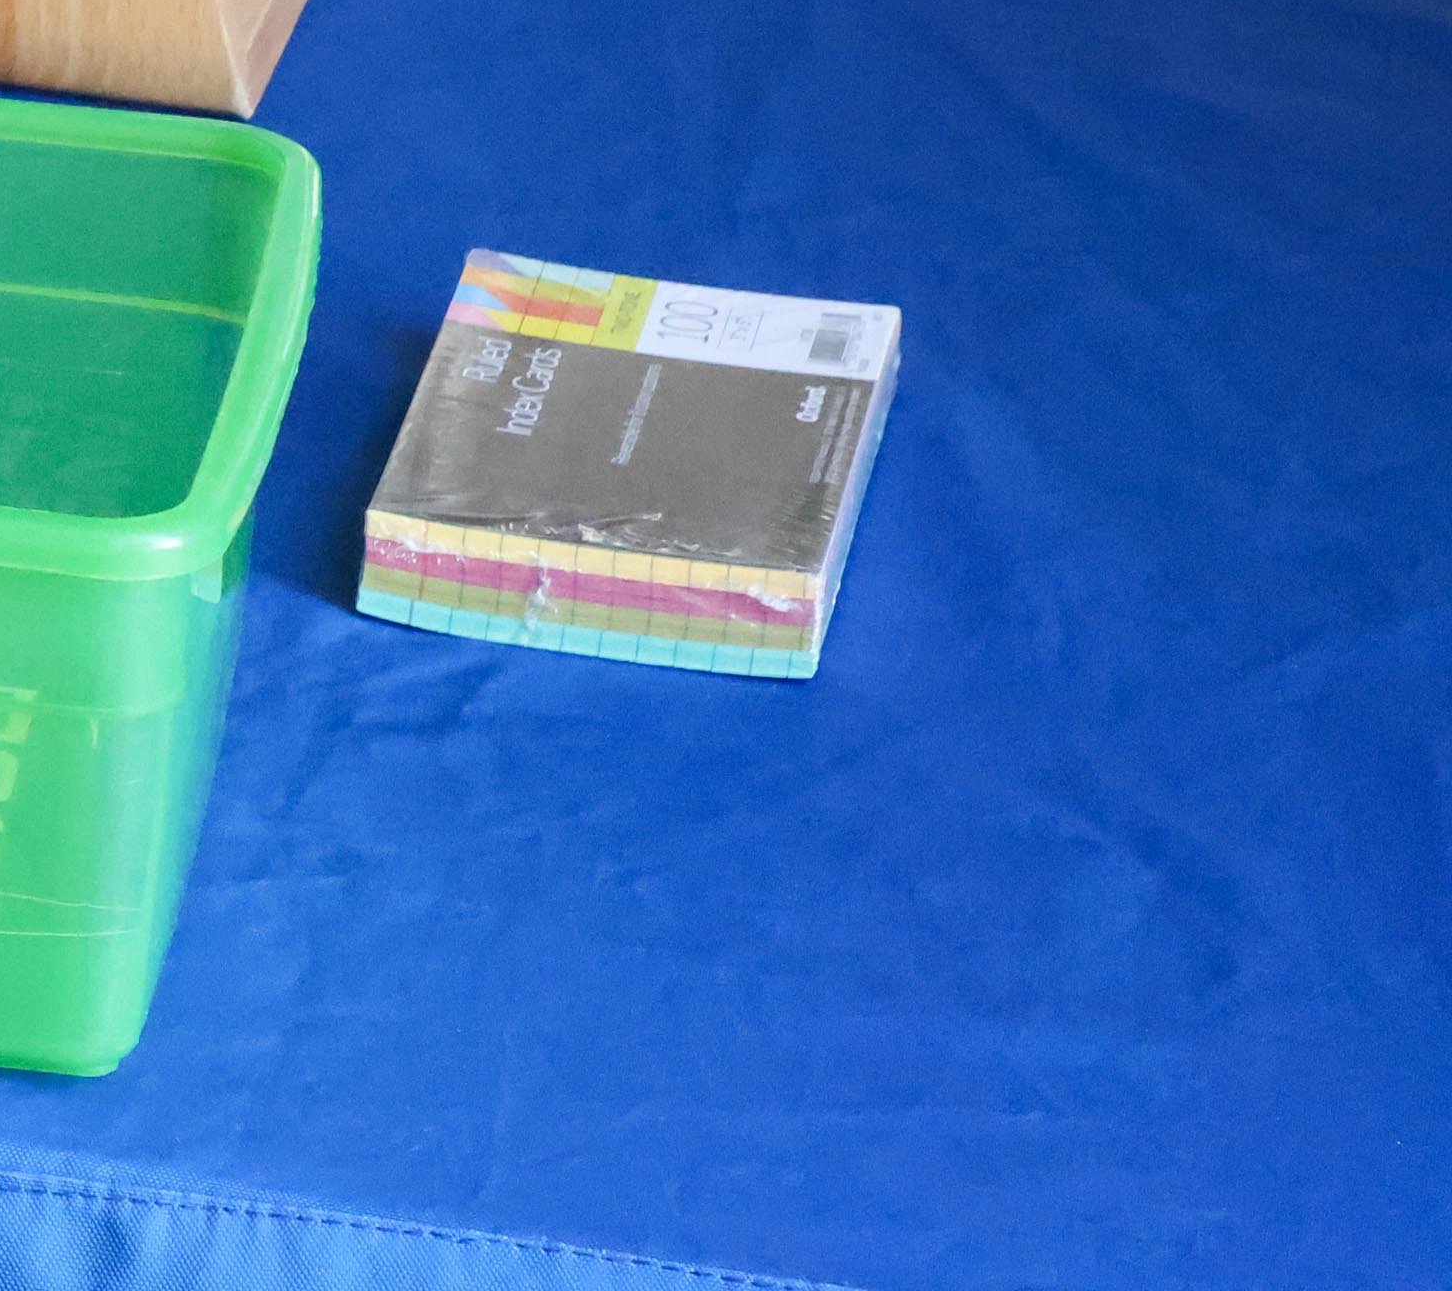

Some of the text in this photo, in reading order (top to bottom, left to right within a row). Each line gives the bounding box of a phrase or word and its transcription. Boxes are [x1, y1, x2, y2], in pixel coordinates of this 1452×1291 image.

[656, 300, 719, 344] 100
[462, 335, 513, 384] Ruled
[496, 347, 563, 437] Index Cards
